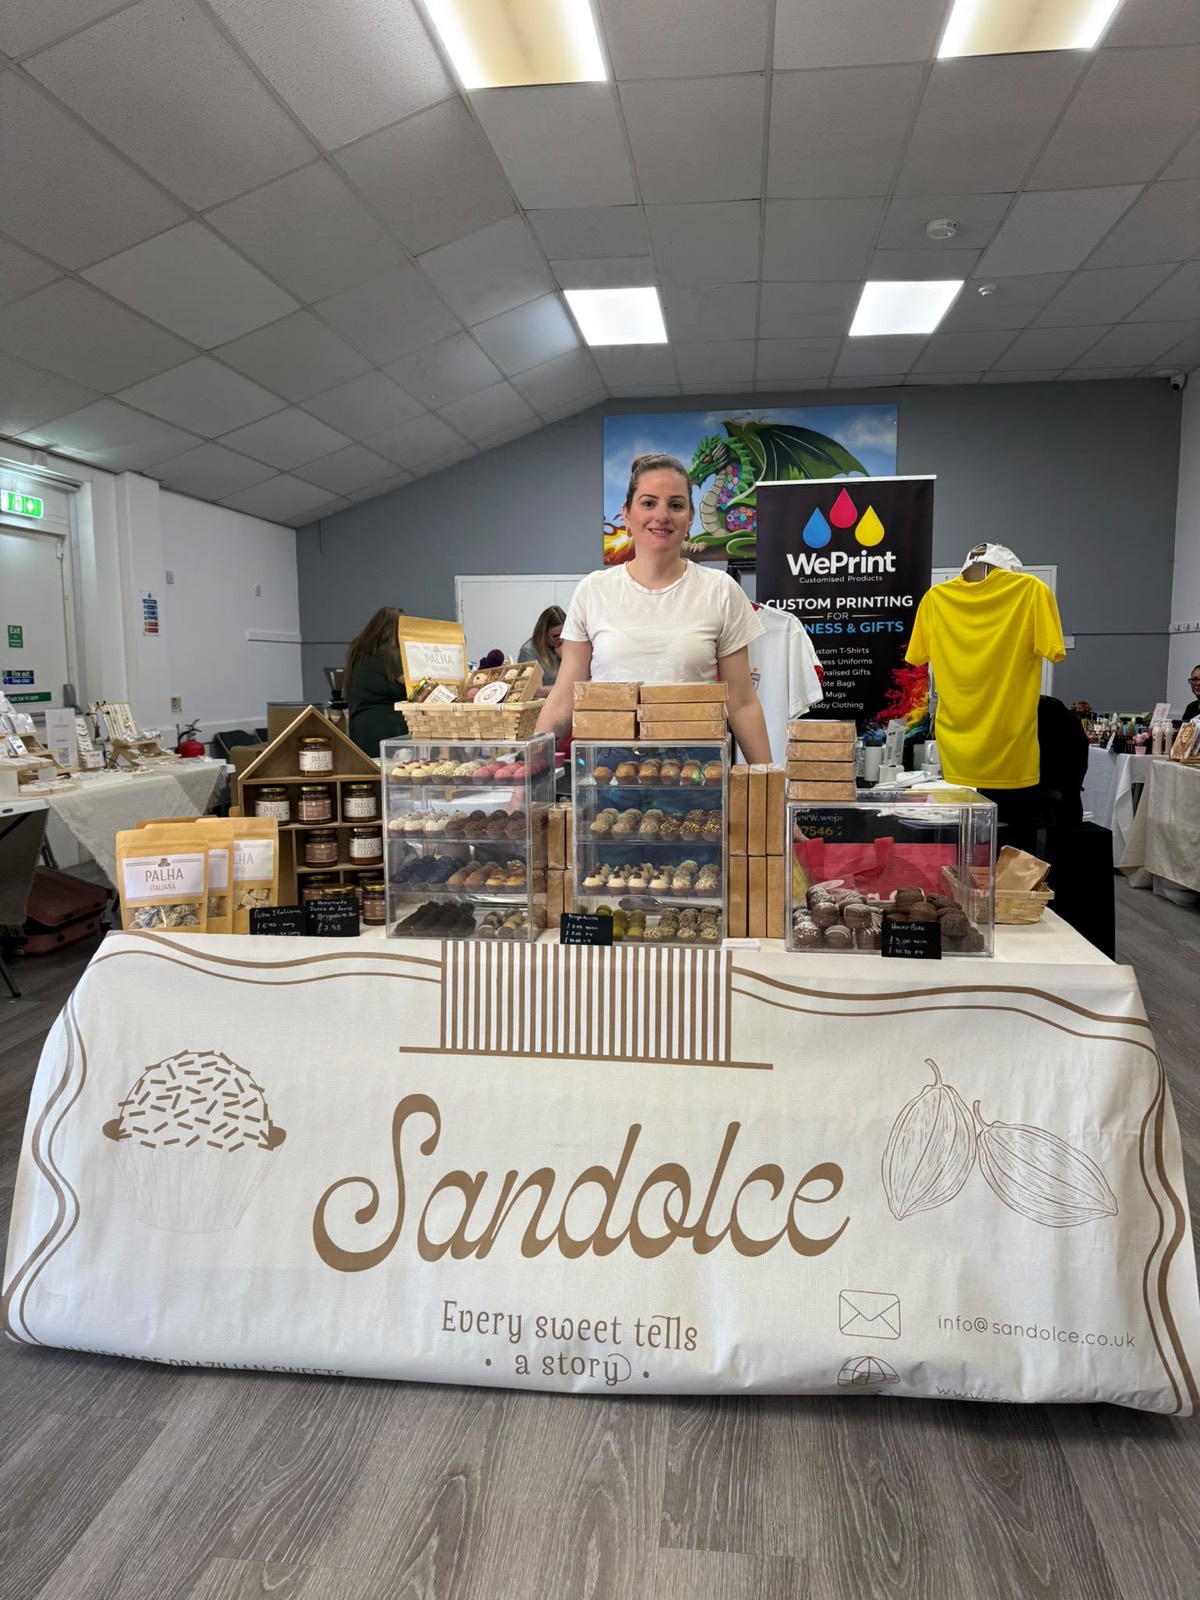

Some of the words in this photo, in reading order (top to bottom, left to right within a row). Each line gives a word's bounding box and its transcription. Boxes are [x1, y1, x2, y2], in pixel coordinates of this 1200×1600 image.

[786, 550, 896, 575] WePrint
[799, 576, 844, 584] Customised
[848, 575, 883, 583] Products
[766, 597, 831, 610] CUSTOM
[836, 595, 913, 608] PRINTING
[827, 612, 849, 620] FOR
[804, 623, 844, 634] NESS
[846, 622, 856, 633] &
[860, 621, 904, 633] GIFTS
[815, 647, 838, 655] ustom
[424, 653, 454, 666] PALHA
[836, 680, 856, 688] Bags
[825, 691, 847, 699] Mugs
[811, 702, 831, 710] Baby
[831, 701, 864, 710] Clothing
[801, 825, 834, 836] 7546
[233, 853, 254, 865] LHA
[145, 868, 184, 882] PALHA
[312, 1093, 850, 1273] Sandolce
[441, 1300, 522, 1344] Every
[535, 1314, 622, 1346] sweet
[634, 1314, 697, 1352] tells
[937, 1314, 1136, 1349] info@sandolce.co.uk
[514, 1355, 531, 1376] a
[541, 1351, 631, 1387] story
